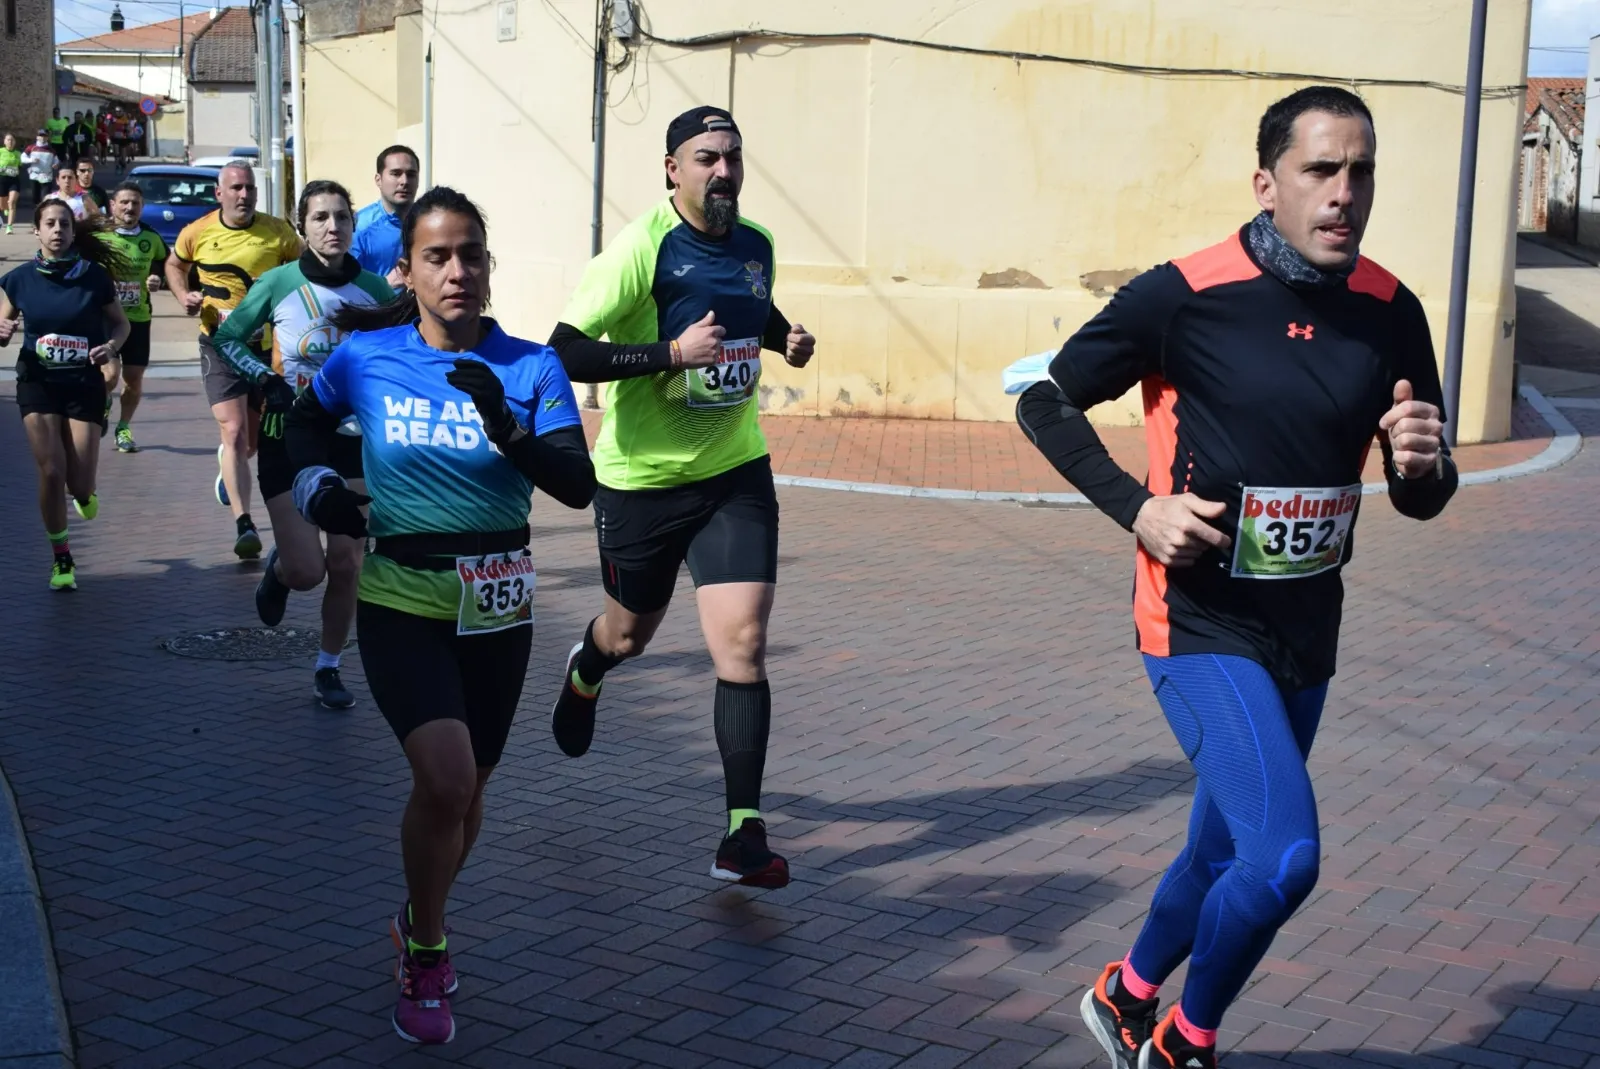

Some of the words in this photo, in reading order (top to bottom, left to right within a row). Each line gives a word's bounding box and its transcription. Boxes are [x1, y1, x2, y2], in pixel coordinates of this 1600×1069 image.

[45, 346, 78, 362] 312
[611, 353, 649, 365] KIPSTA
[717, 345, 760, 364] dunia
[704, 362, 751, 391] 340
[383, 395, 431, 419] WE
[440, 400, 484, 427] AR
[1243, 492, 1359, 520] bedunia
[1262, 519, 1336, 556] 352
[477, 577, 524, 612] 353
